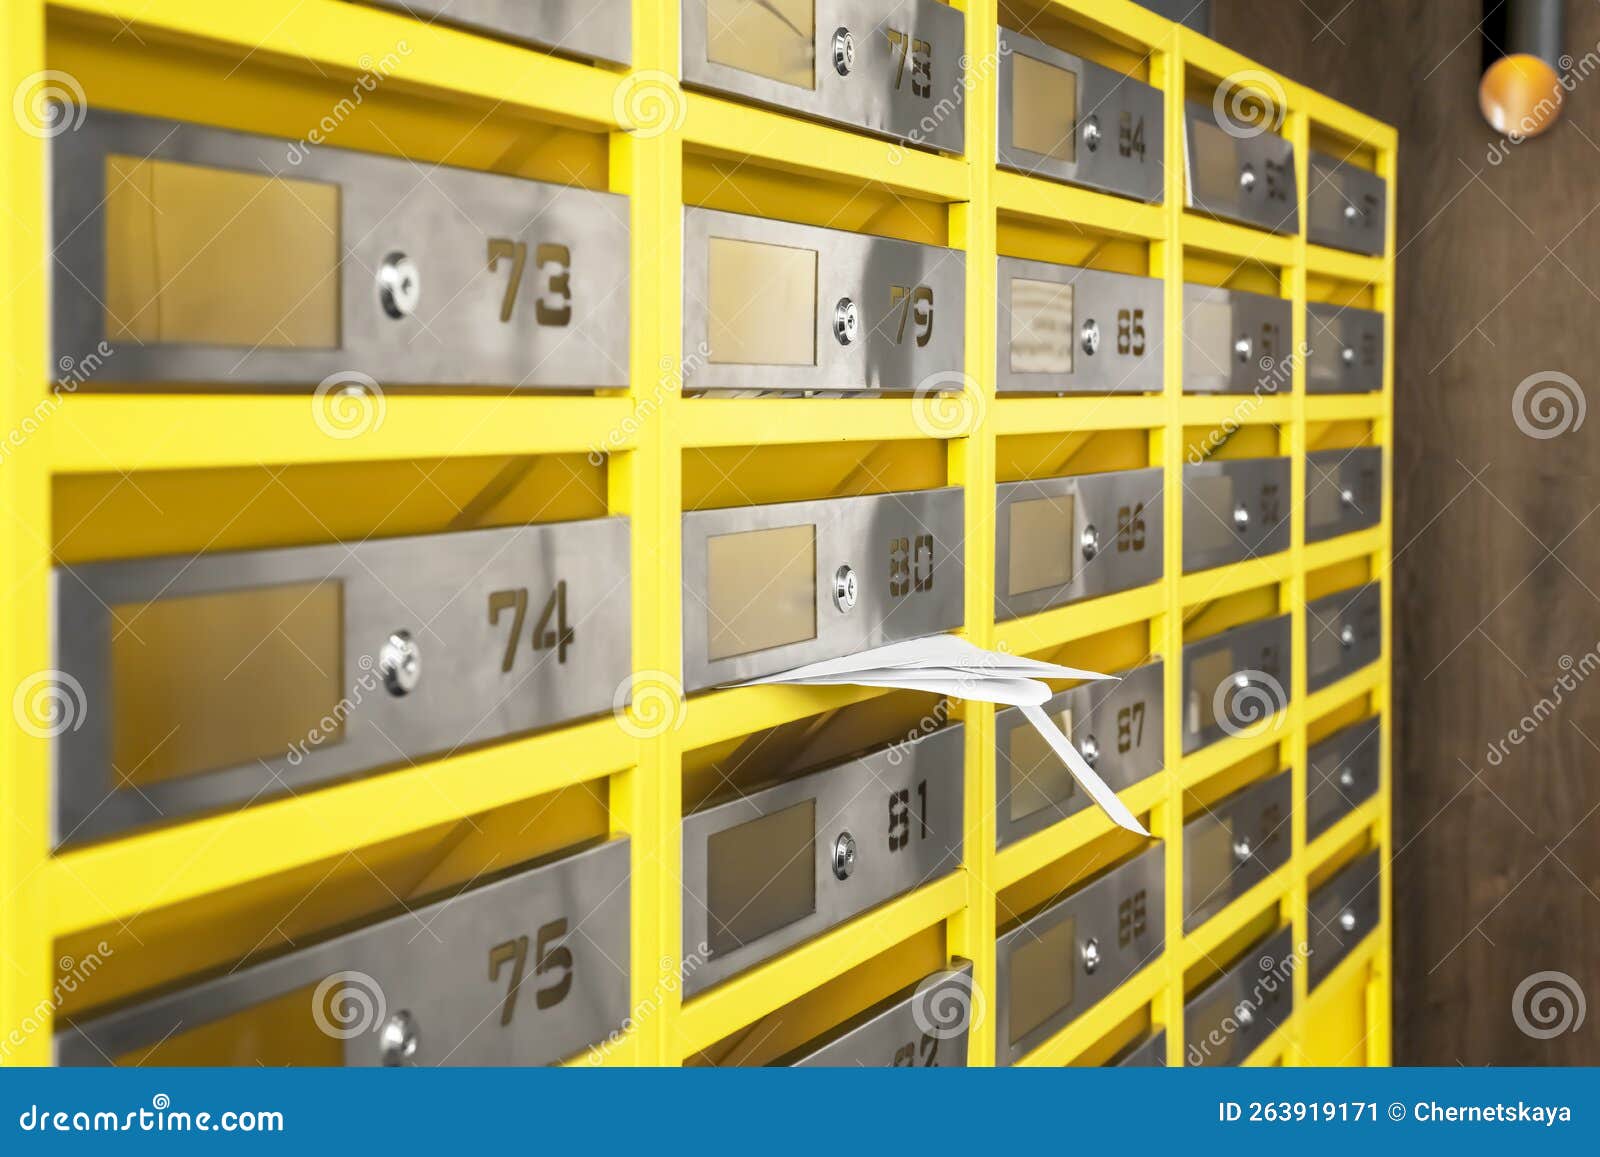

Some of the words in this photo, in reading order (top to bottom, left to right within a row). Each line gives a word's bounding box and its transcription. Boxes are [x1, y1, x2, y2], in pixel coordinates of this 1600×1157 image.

[1118, 110, 1147, 163] 84
[486, 237, 572, 327] 73
[889, 285, 934, 348] 79
[1116, 309, 1146, 357] 85
[1116, 502, 1146, 552] 86
[888, 534, 934, 597] 80
[487, 580, 575, 673] 74
[1117, 701, 1146, 754] 87
[887, 779, 928, 853] 81
[487, 917, 574, 1027] 75
